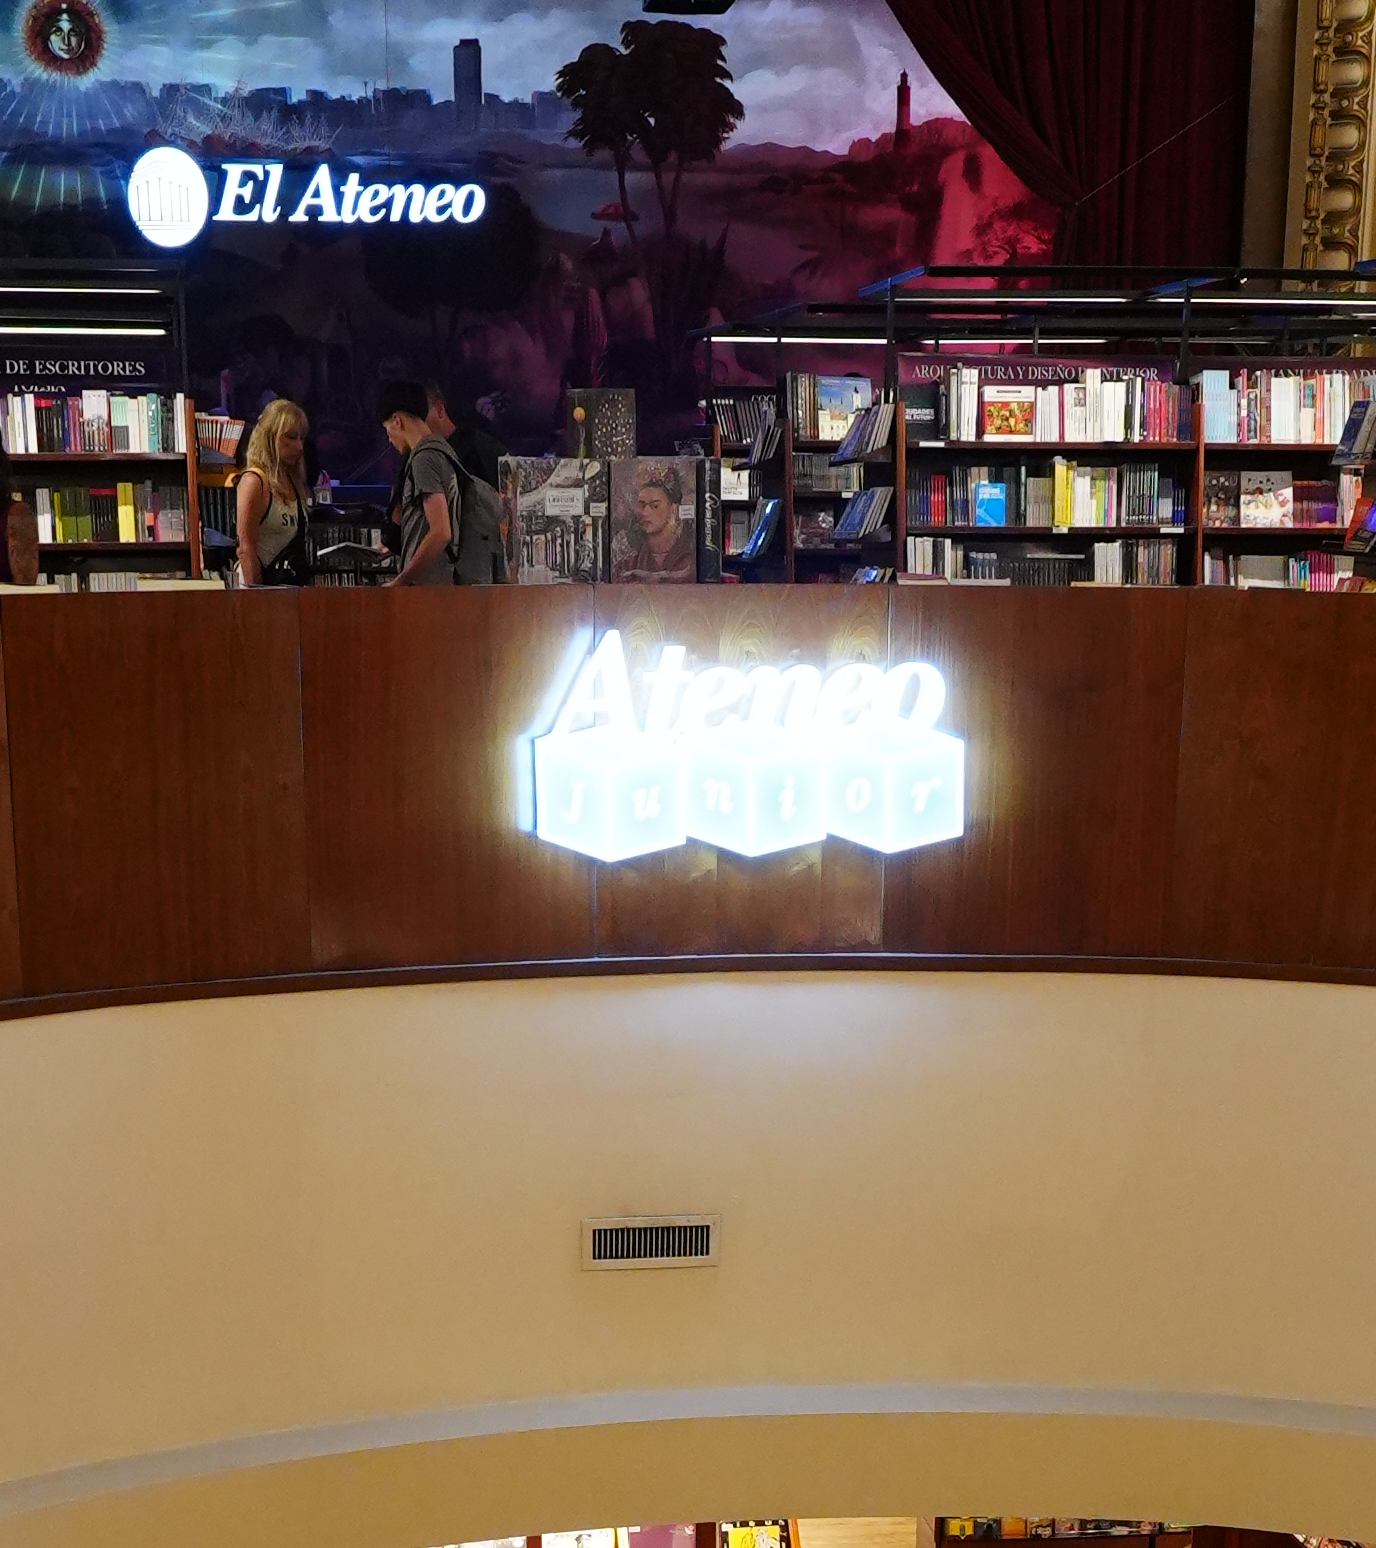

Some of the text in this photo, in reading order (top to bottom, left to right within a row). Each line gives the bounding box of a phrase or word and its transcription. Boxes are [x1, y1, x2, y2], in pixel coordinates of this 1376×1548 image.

[212, 163, 486, 224] El Ateneo
[6, 359, 30, 375] DE
[34, 359, 145, 377] ESCRITORES
[1016, 366, 1025, 379] Y
[1028, 363, 1075, 380] DISEÑO
[551, 628, 948, 734] Ateneo
[559, 773, 943, 825] Junior
